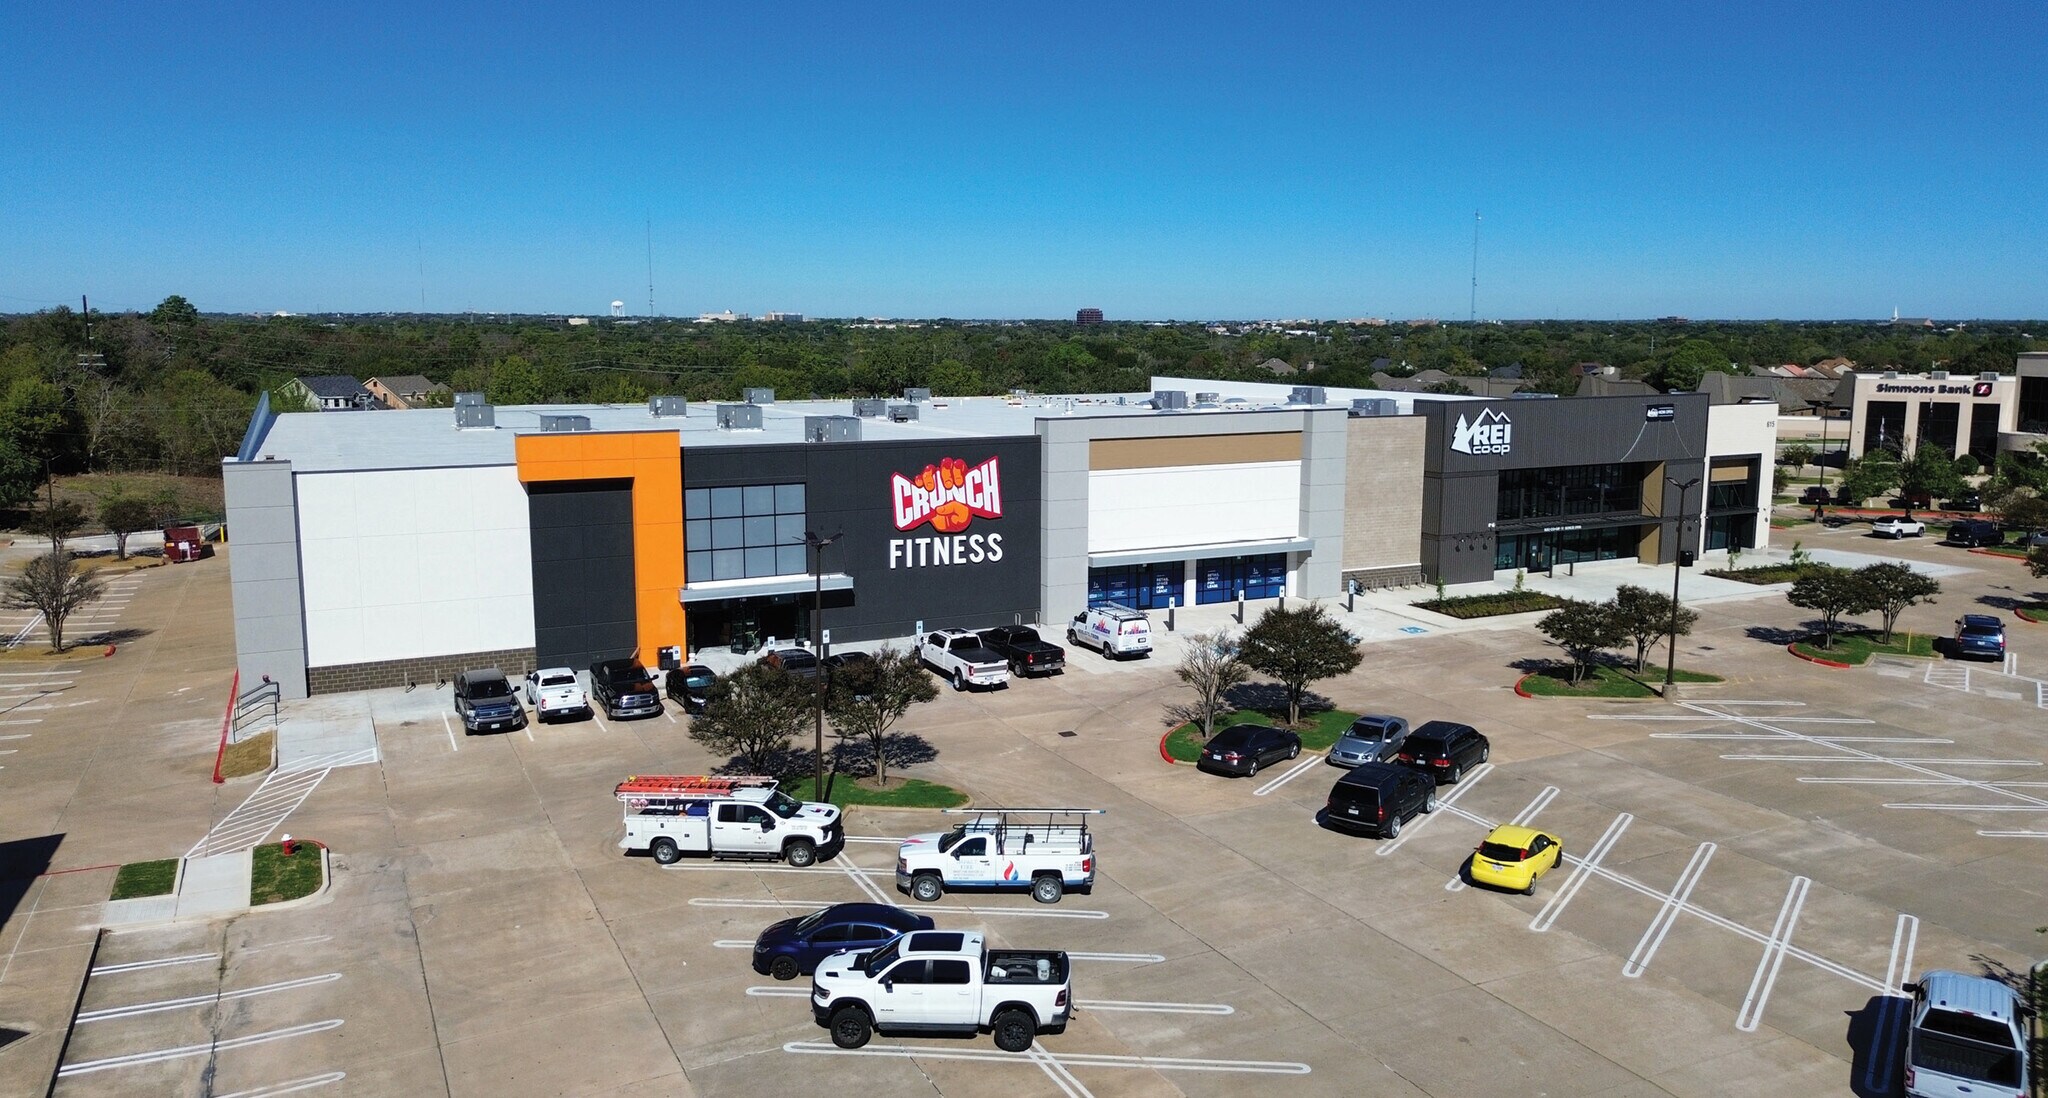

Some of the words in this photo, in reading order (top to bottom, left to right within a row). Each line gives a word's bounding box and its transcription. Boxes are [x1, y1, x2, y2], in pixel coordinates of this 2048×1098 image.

[1876, 384, 1935, 394] Simmons
[1938, 385, 1971, 394] Bank
[1473, 424, 1511, 445] REI
[892, 458, 1001, 528] CRUNCH
[890, 533, 1003, 569] FITNESS
